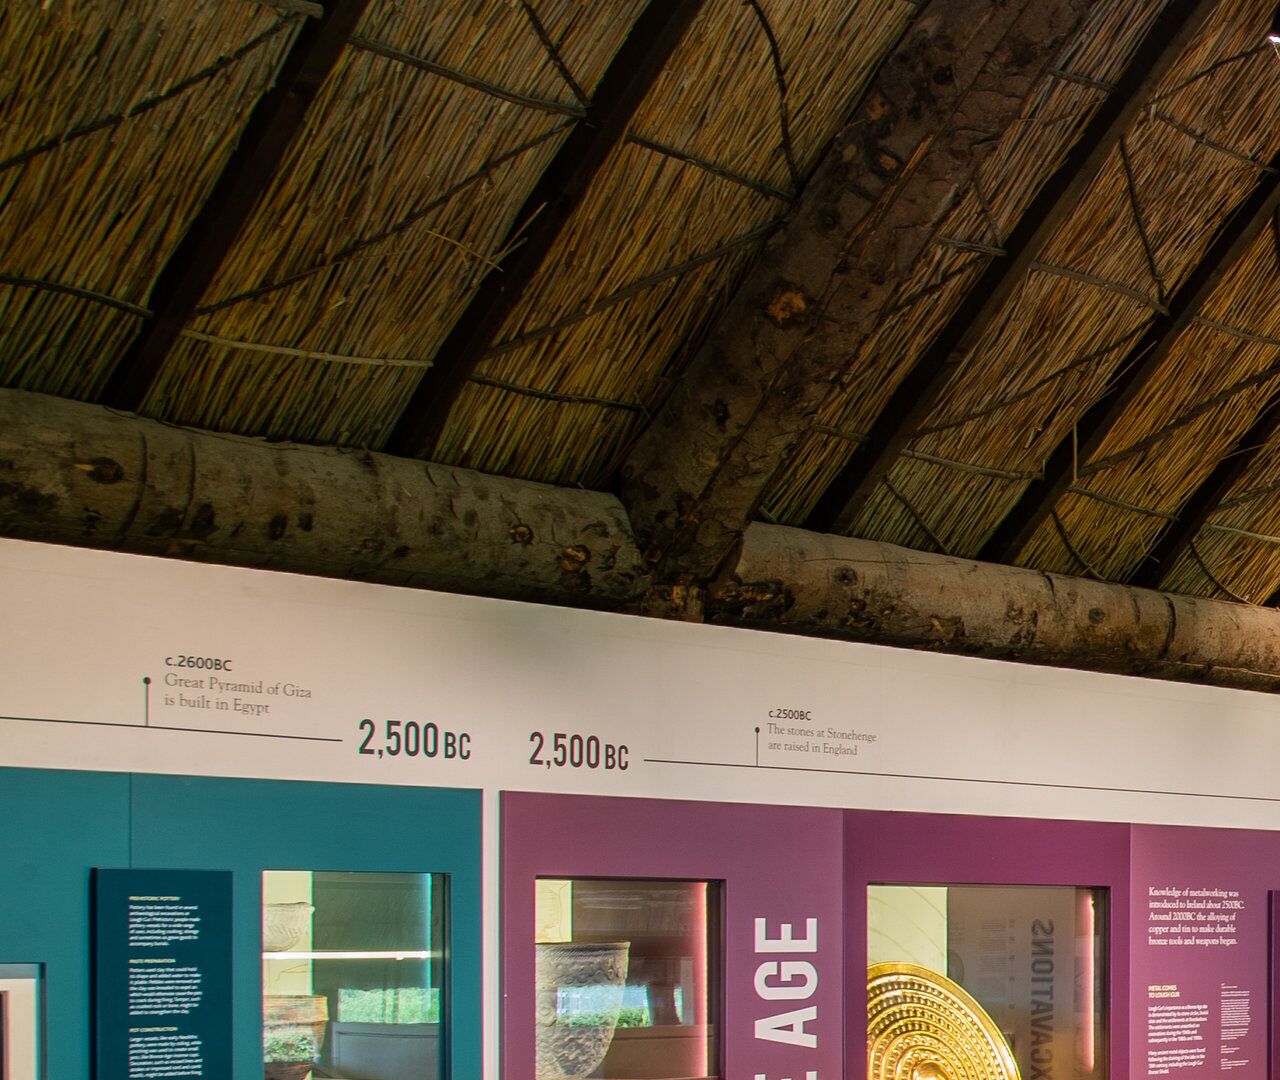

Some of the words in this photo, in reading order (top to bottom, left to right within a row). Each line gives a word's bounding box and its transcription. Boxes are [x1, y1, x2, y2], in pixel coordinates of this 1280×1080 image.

[165, 655, 232, 671] c.2600BC
[165, 673, 204, 689] Great
[209, 676, 262, 696] Pyramid
[266, 682, 281, 695] of
[283, 683, 312, 699] Giza
[165, 693, 175, 706] is
[179, 694, 211, 709] built
[215, 698, 229, 711] in
[233, 699, 270, 716] Egypt
[768, 709, 812, 721] c.2500BC
[358, 719, 438, 759] 2,500
[444, 731, 471, 760] BC
[768, 723, 784, 736] The
[787, 726, 814, 738] stones
[816, 728, 825, 739] at
[827, 727, 877, 743] Stonehenge
[529, 731, 599, 769] 2,500
[604, 744, 629, 770] BC
[768, 741, 782, 751] are
[785, 740, 809, 752] raised
[812, 742, 821, 753] in
[823, 742, 857, 757] England
[1148, 887, 1181, 898] Knowledge
[1182, 887, 1189, 896] of
[1190, 888, 1227, 899] metalworking
[1148, 899, 1179, 908] introduced
[1187, 900, 1205, 909] Ireland
[1206, 900, 1221, 909] about
[1148, 912, 1171, 920] Around
[1197, 912, 1206, 921] the
[1207, 912, 1229, 922] alloying
[1230, 912, 1236, 921] of
[1148, 925, 1169, 935] copper
[1170, 924, 1181, 933] and
[1182, 924, 1191, 933] tin
[1199, 924, 1214, 933] make
[1215, 924, 1236, 933] durable
[1148, 936, 1168, 945] bronze
[1169, 936, 1183, 945] tools
[1184, 936, 1195, 945] and
[1196, 938, 1219, 946] weapons
[1220, 936, 1238, 946] began.
[754, 917, 818, 1049] AGE
